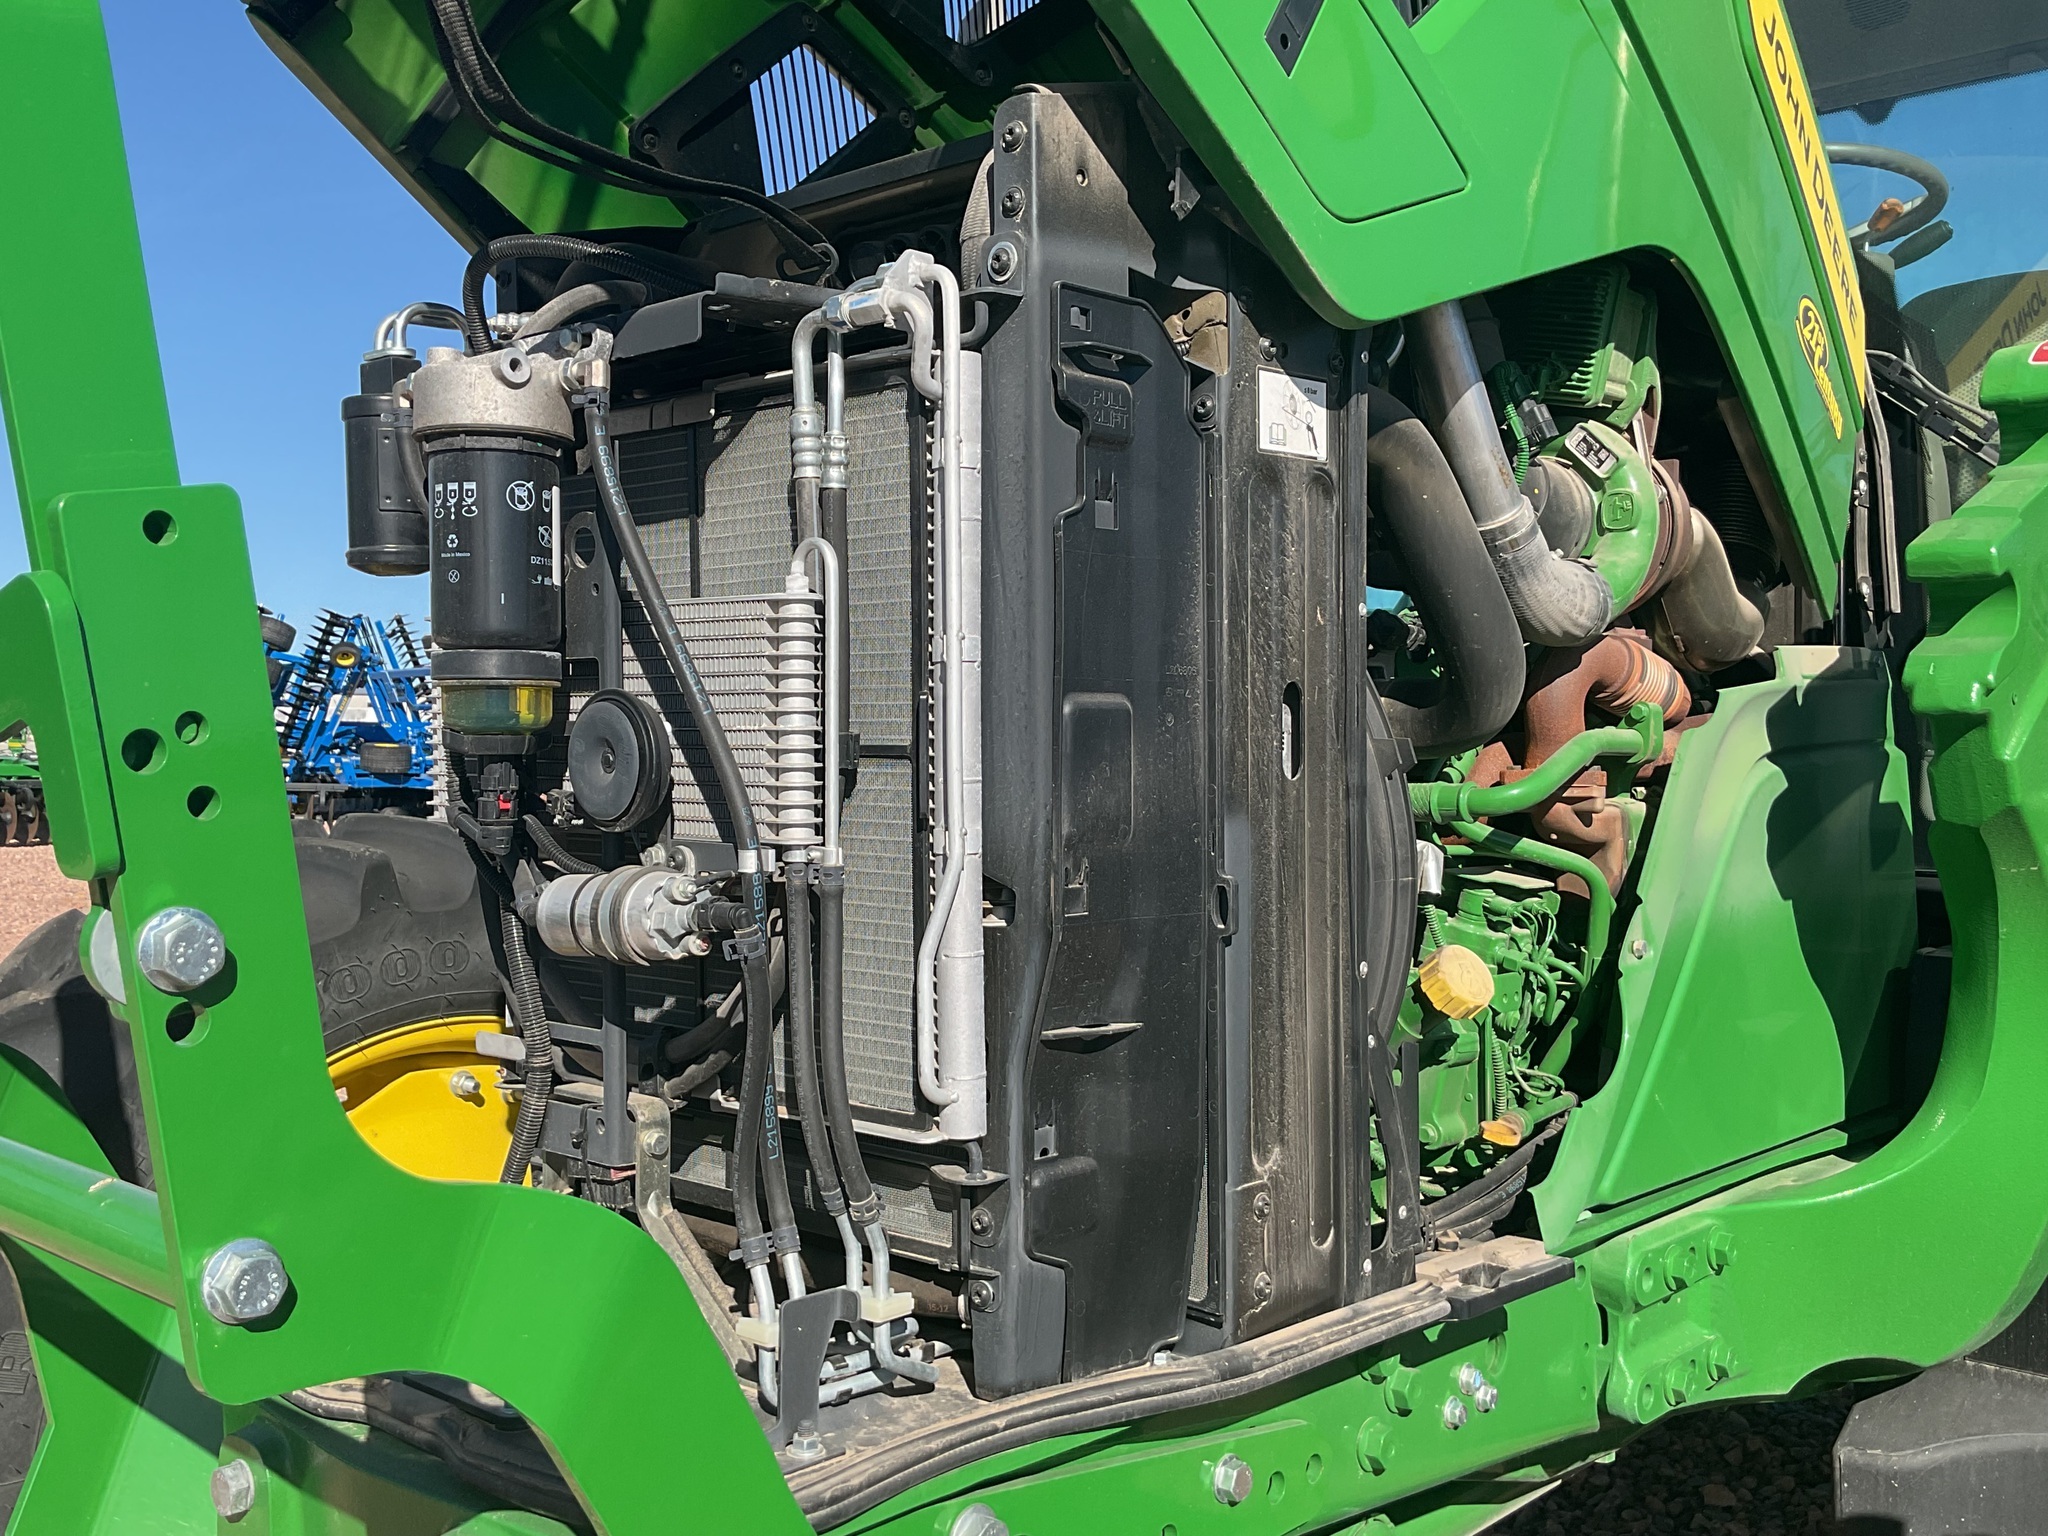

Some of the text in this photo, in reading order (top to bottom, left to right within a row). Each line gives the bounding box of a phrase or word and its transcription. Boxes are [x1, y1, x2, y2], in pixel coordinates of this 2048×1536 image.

[1762, 13, 1858, 340] JOHN DEERE
[1093, 390, 1127, 410] PULL
[530, 555, 553, 566] DZ115
